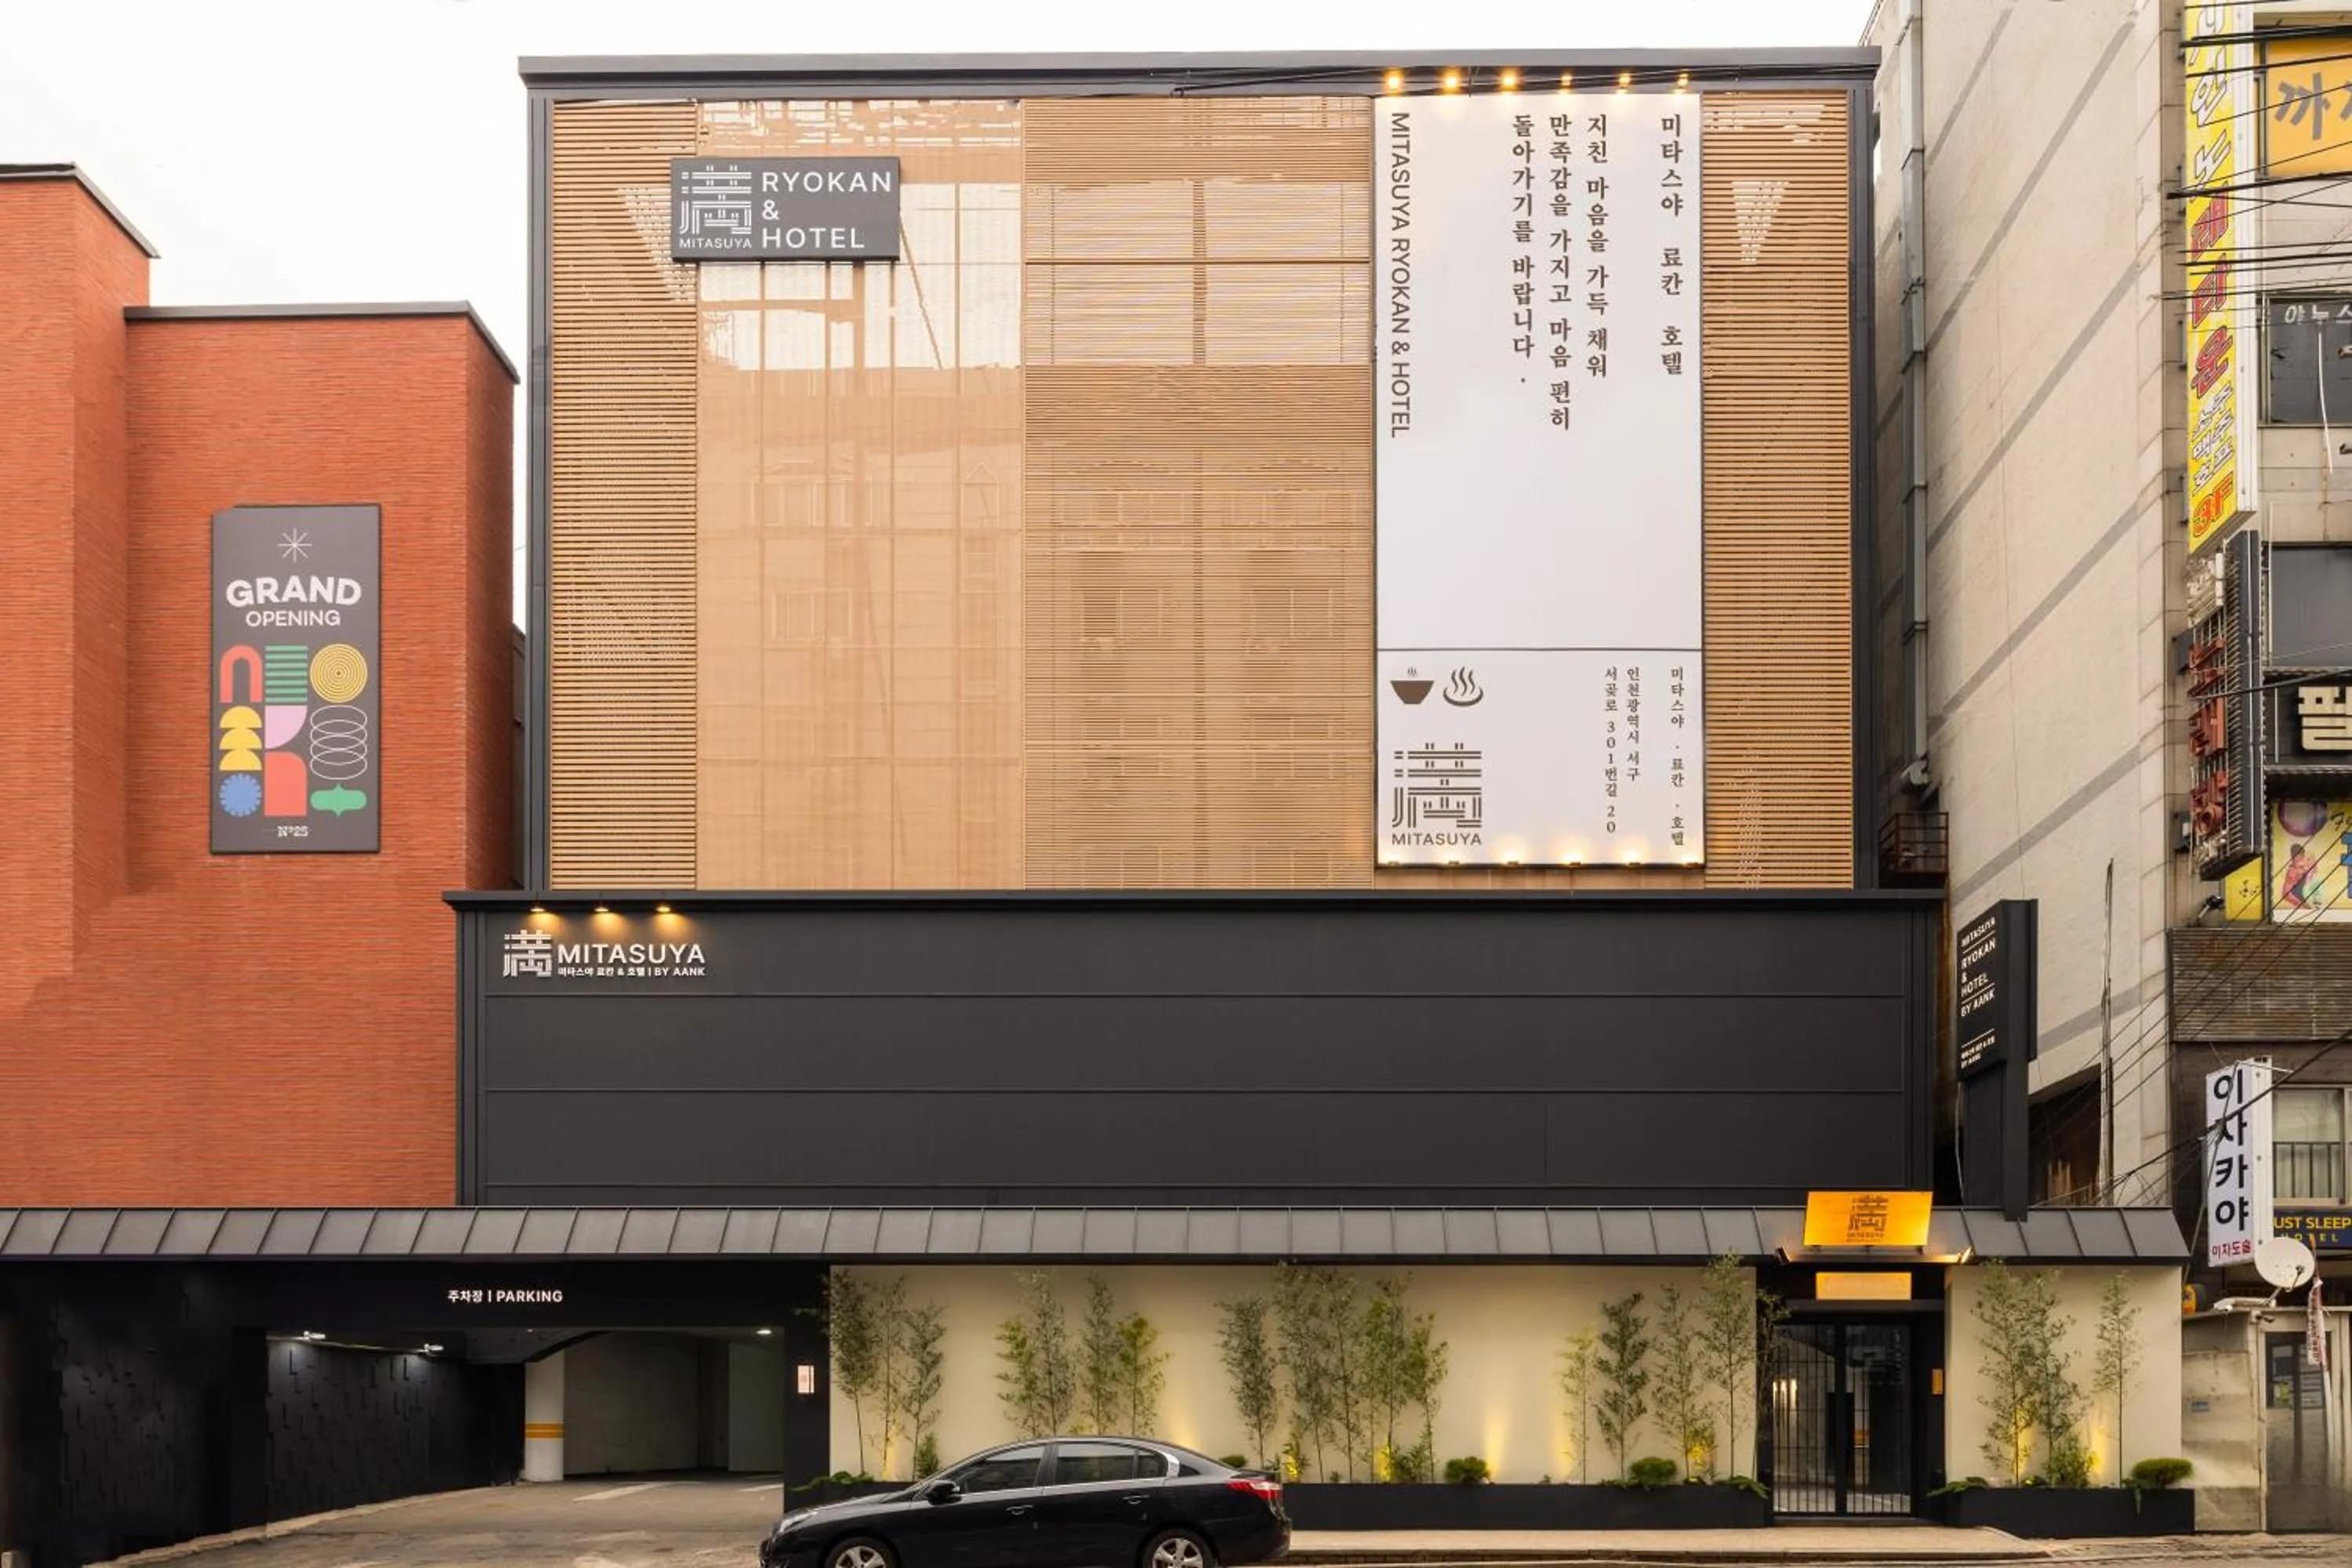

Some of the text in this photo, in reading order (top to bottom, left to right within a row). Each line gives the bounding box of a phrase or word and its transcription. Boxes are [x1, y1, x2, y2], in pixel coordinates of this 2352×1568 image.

[761, 171, 891, 193] RYOKAN
[1512, 114, 1535, 243] 돌아가기를
[761, 199, 779, 220] &
[679, 238, 752, 249] MITASUYA
[761, 227, 865, 249] HOTEL
[1587, 114, 1610, 378] 지친 마음을 가득 채워
[1661, 114, 1683, 375] 미타스야 료칸 호텔
[1392, 112, 1410, 438] MITASUYA RYOKAN & HOTEL
[1549, 114, 1572, 430] 만족감을 가지고 마음 편히
[225, 575, 361, 608] GRAND
[245, 609, 341, 627] OPENING
[1671, 666, 1685, 728] 미타스야
[1627, 666, 1640, 782] 인천광역시 서구
[1606, 805, 1617, 833] 20
[1392, 833, 1482, 846] MITASUYA
[557, 943, 706, 964] MITASUYA
[1961, 938, 1995, 970] RYOKAN
[654, 967, 669, 976] BY
[673, 967, 706, 976] AANK
[1961, 972, 1989, 997] HOTEL
[1961, 1002, 1973, 1017] BY
[2306, 1216, 2351, 1229] SLEEP
[448, 1290, 483, 1303] 주차장
[496, 1290, 564, 1302] PARKING
